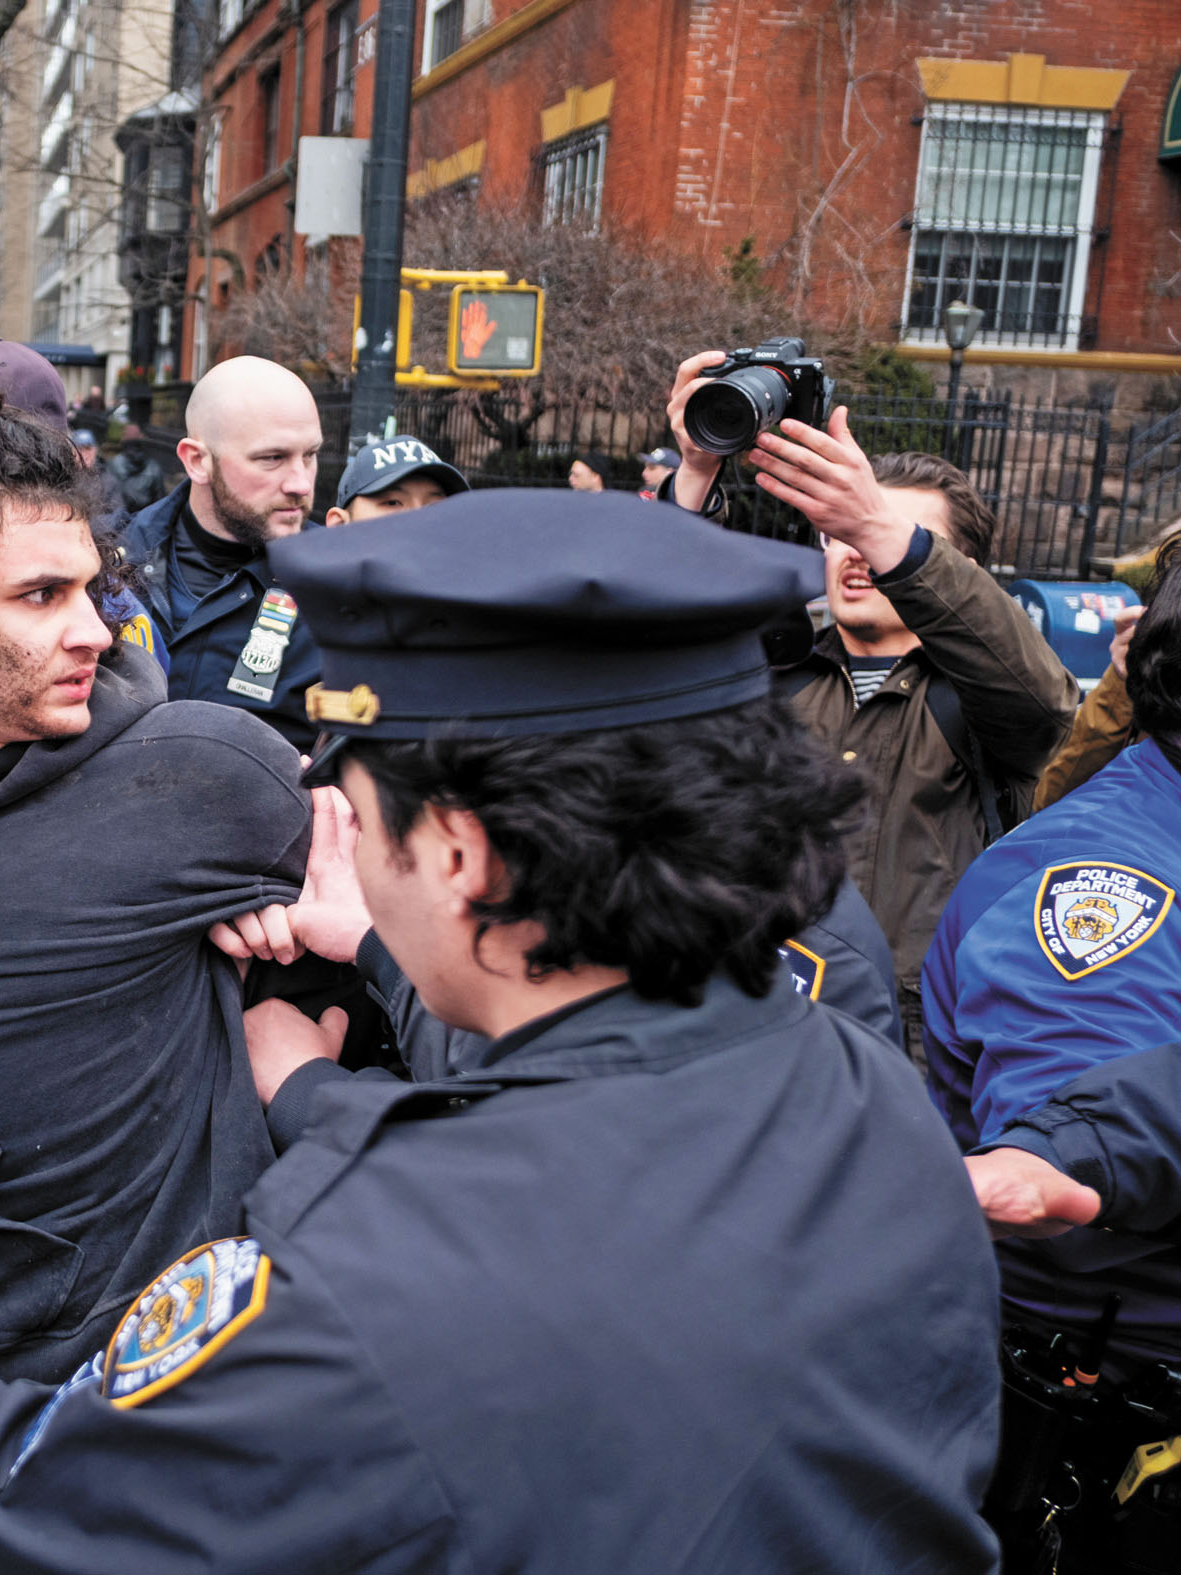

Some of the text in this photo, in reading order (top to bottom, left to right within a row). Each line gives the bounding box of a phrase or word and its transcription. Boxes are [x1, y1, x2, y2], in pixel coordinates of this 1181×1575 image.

[1049, 880, 1157, 910] DEPARTMENT
[1076, 869, 1139, 889] POLICE
[1041, 908, 1066, 955] CITY OF
[1084, 915, 1154, 966] NEW YORK
